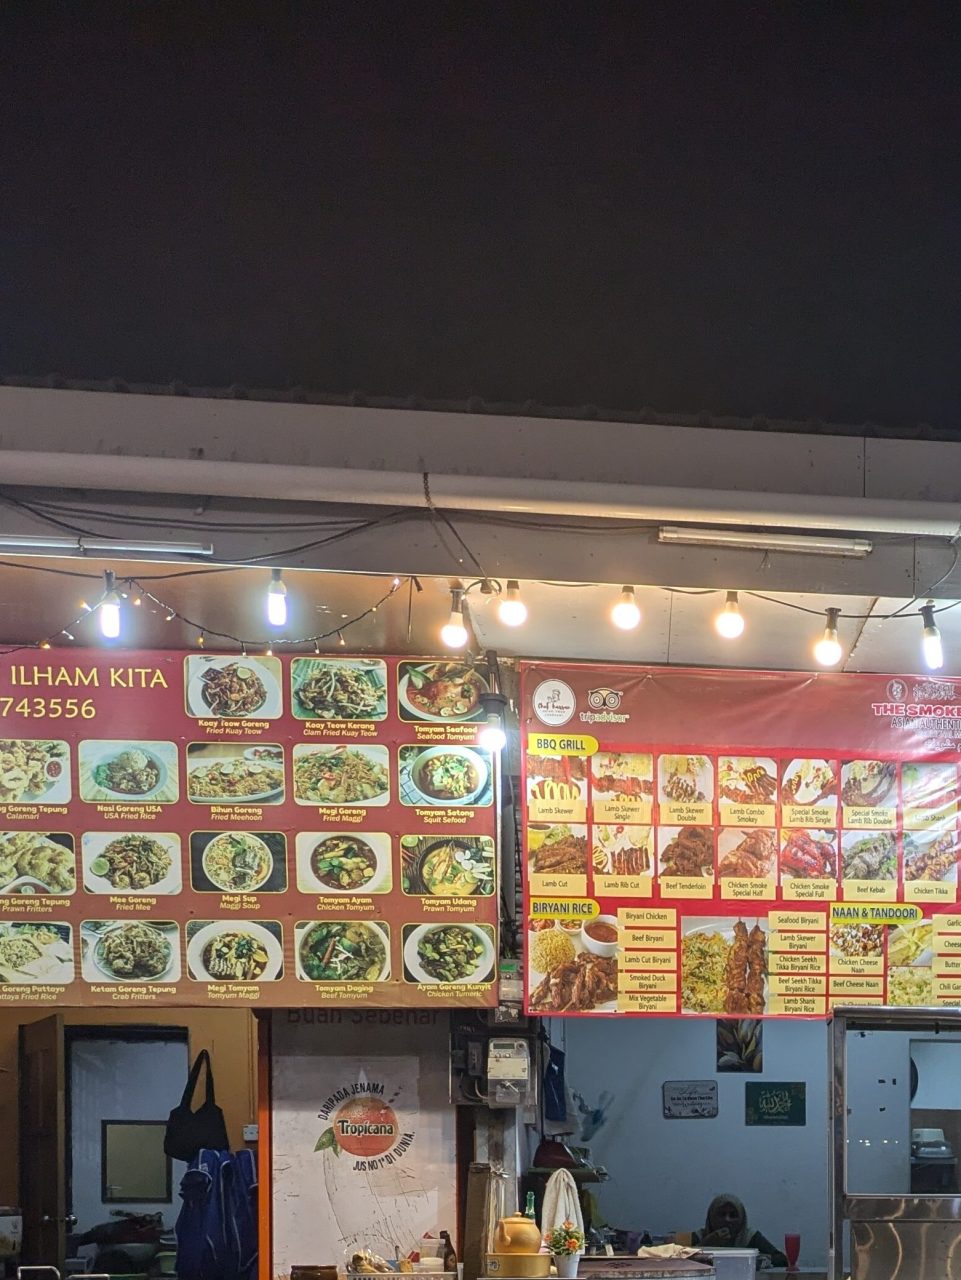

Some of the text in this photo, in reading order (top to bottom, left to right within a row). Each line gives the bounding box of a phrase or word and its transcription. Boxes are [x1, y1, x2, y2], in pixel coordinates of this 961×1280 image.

[11, 665, 168, 688] ILHAM KITA
[0, 698, 96, 719] 743556
[872, 703, 906, 716] THE
[537, 739, 586, 750] BBQ GRILL
[8, 806, 37, 814] Goreng
[38, 806, 68, 815] Tepung
[116, 805, 144, 813] Goreng
[235, 807, 262, 815] Goreng
[339, 808, 367, 816] Goreng
[11, 898, 39, 907] Goreng
[42, 898, 70, 907] Tepung
[128, 897, 157, 905] Goreng
[242, 895, 257, 903] Sup
[532, 903, 593, 914] BIRYANI RICE
[833, 908, 918, 919] NAAN & TANDOORI
[118, 986, 147, 994] Goreng
[148, 986, 177, 994] Tepung
[318, 1082, 384, 1120] DARIPADA JENAMA
[337, 1120, 393, 1136] Tropicana
[353, 1161, 367, 1171] JUS
[368, 1160, 378, 1171] NO
[385, 1155, 397, 1164] DI
[393, 1131, 415, 1157] DUNIA.
